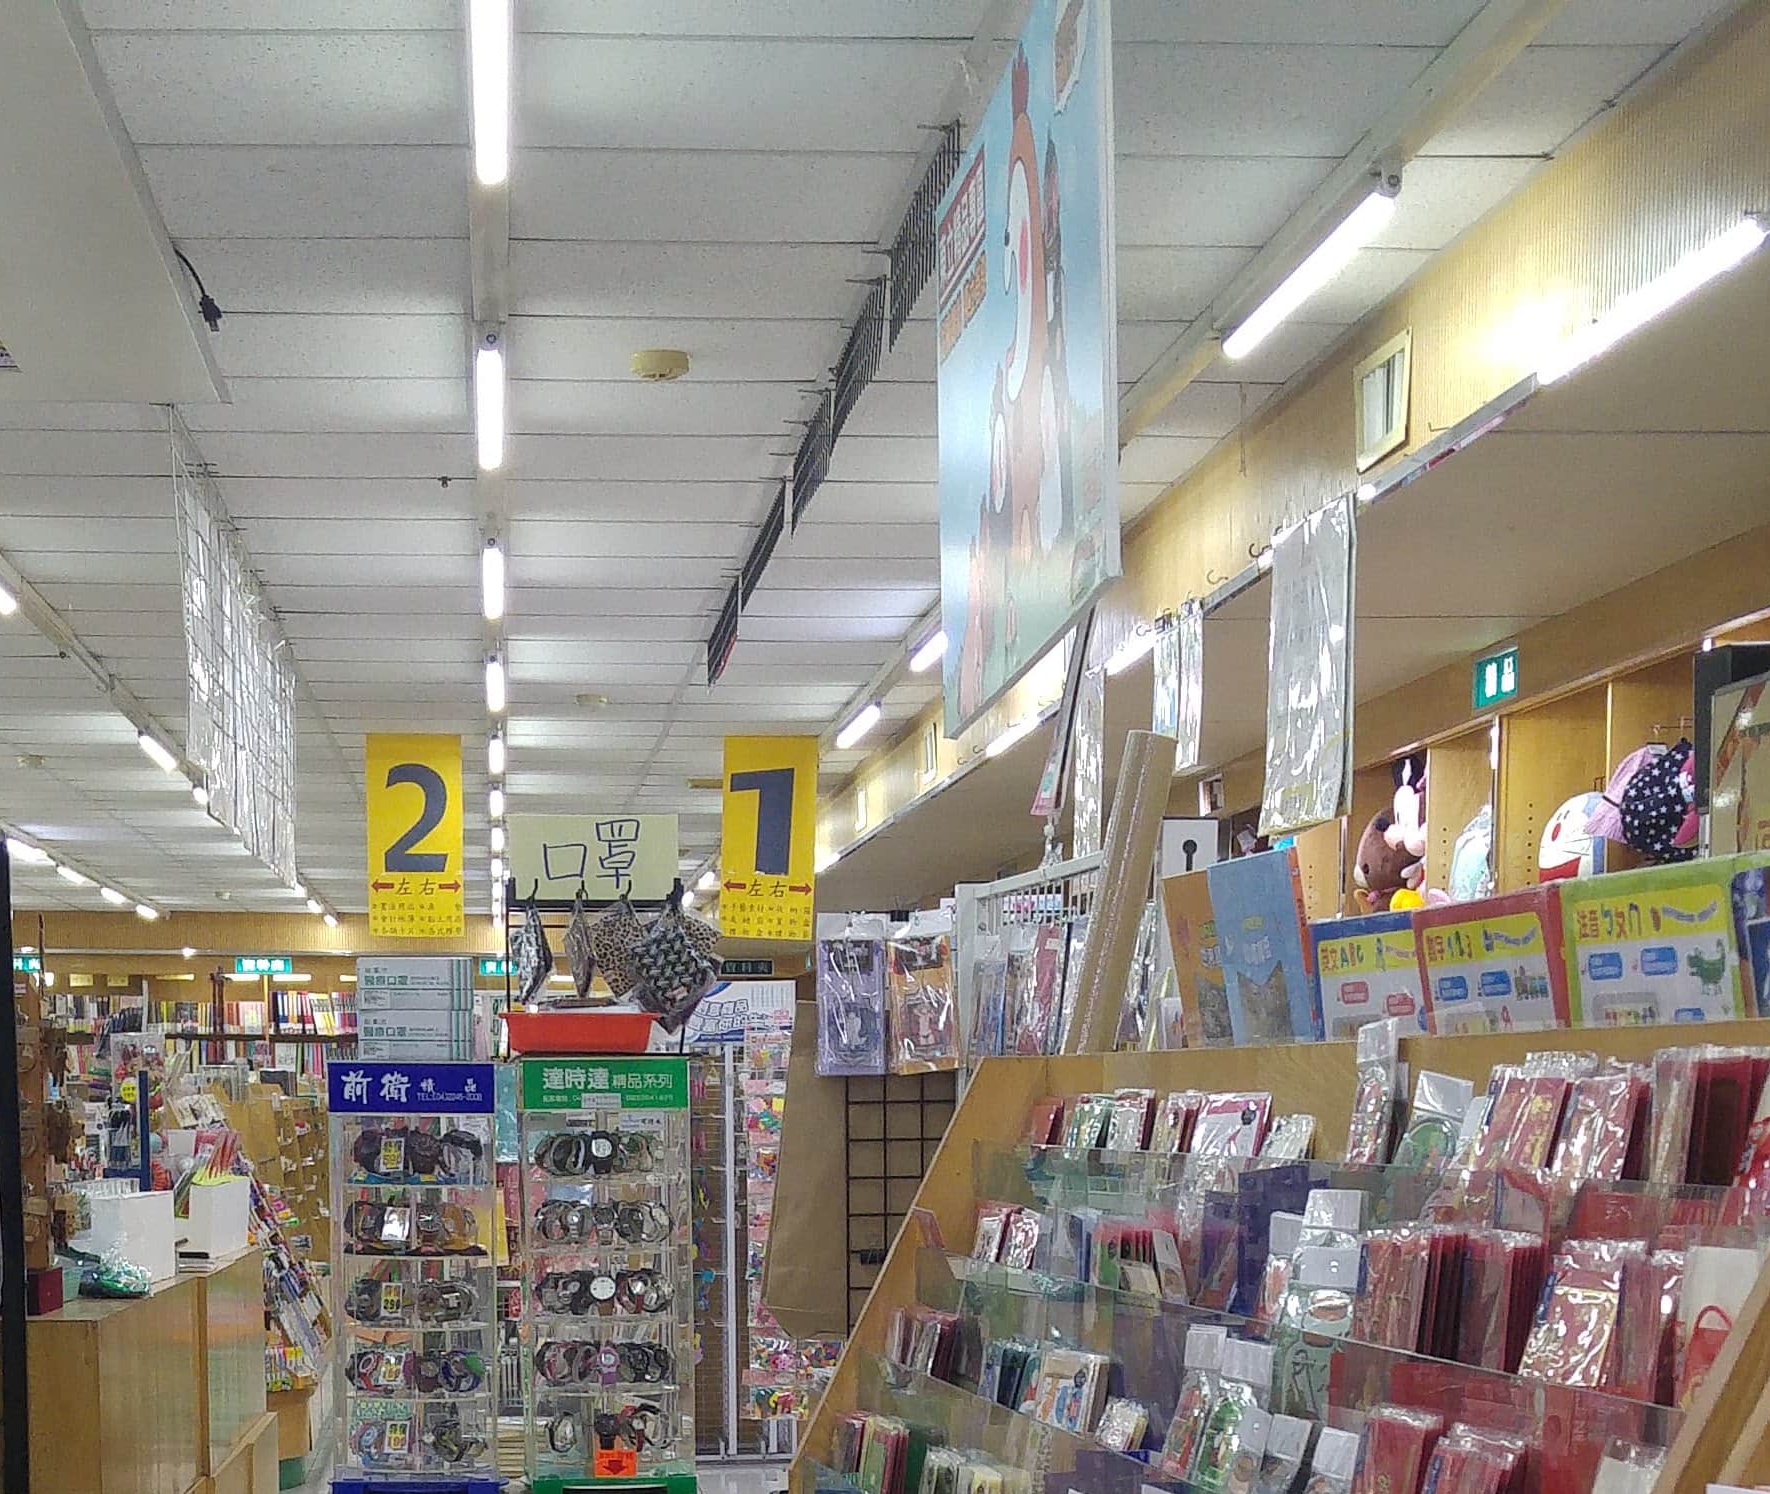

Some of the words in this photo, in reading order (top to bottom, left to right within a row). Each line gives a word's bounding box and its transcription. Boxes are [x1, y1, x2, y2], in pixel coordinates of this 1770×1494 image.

[383, 763, 449, 874] 2
[541, 818, 641, 884] 口罩
[730, 767, 796, 876] 1
[394, 876, 436, 897] 左右
[747, 878, 789, 898] 左右
